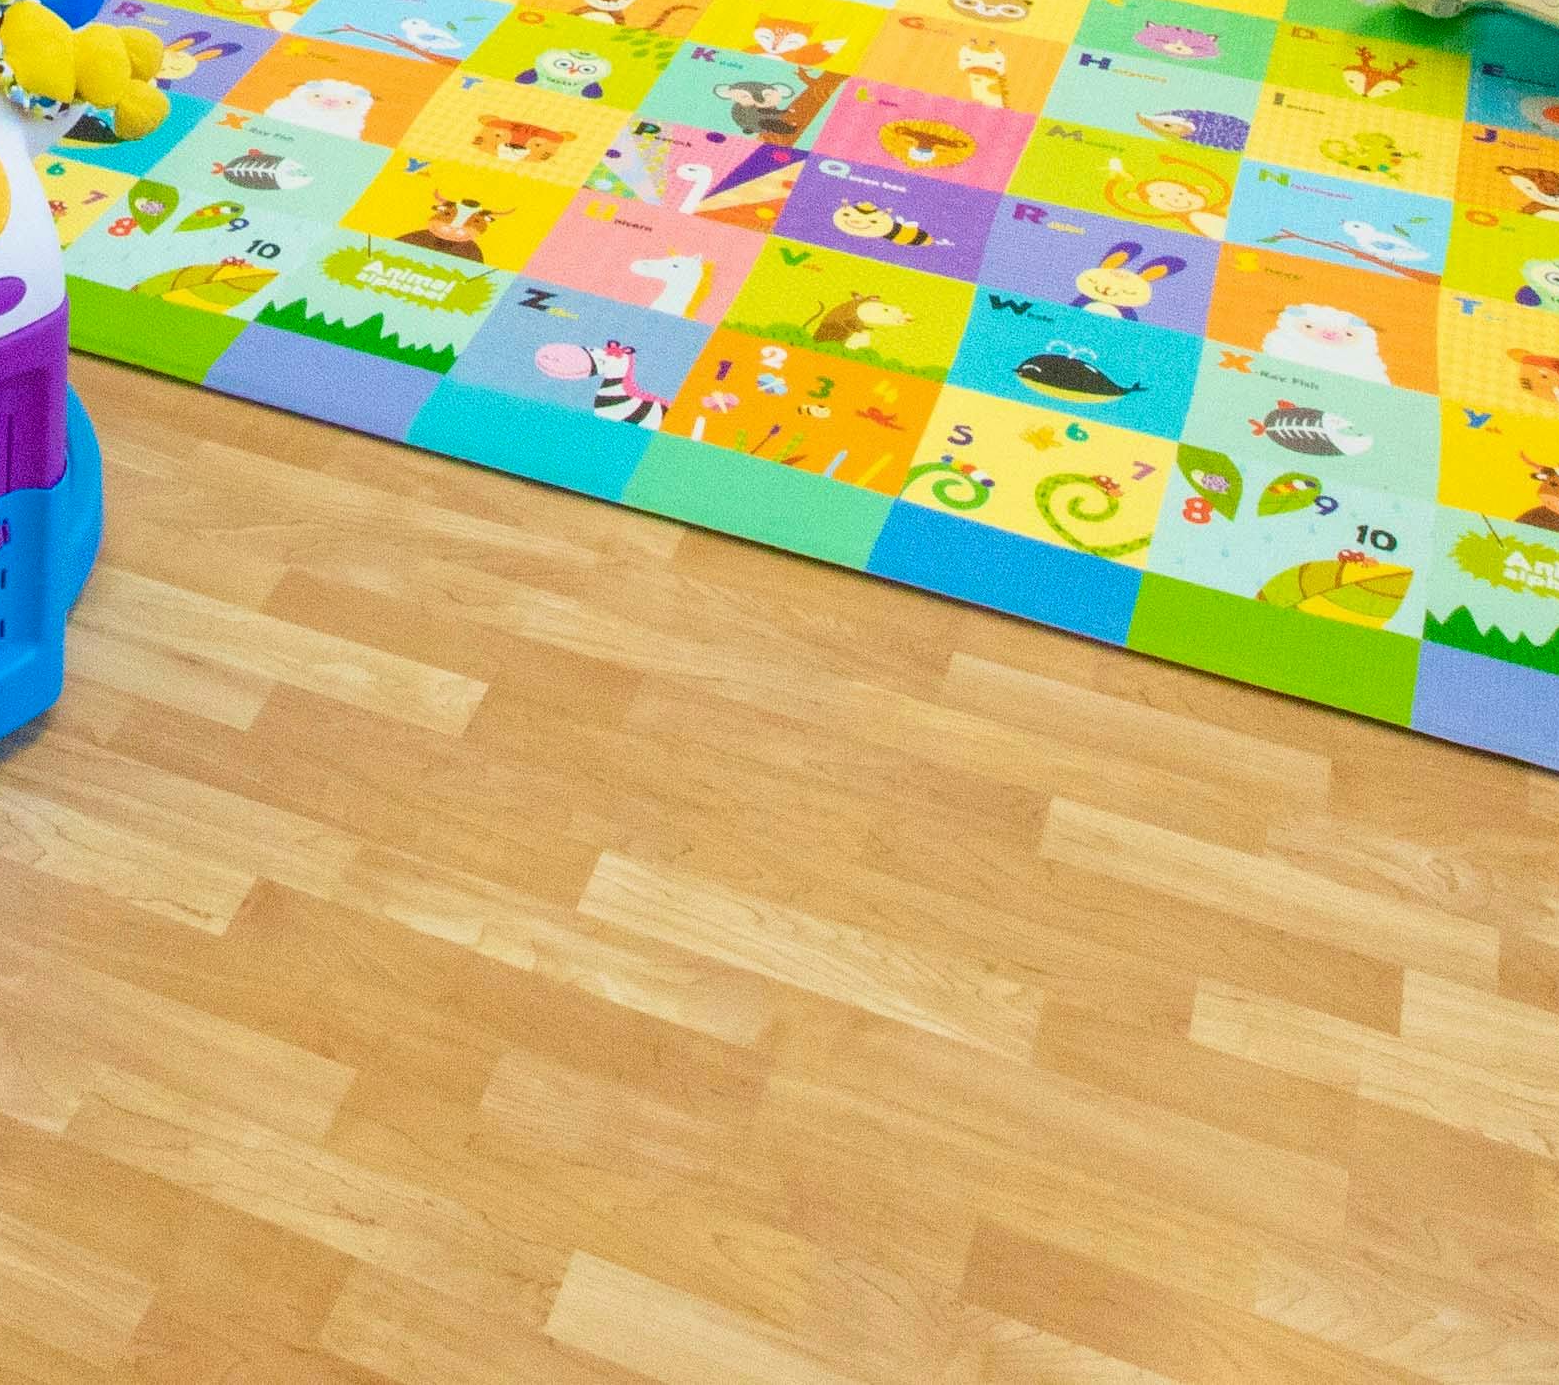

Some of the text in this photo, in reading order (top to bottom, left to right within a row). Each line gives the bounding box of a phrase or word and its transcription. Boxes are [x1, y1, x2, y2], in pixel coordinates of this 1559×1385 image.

[245, 238, 282, 260] 10
[759, 345, 788, 370] 2
[715, 359, 734, 381] 1
[807, 375, 835, 400] 3
[1065, 422, 1090, 443] 6
[1131, 460, 1156, 481] 7
[1182, 495, 1214, 525] 8
[1314, 494, 1339, 516] 9
[1355, 523, 1398, 553] 10
